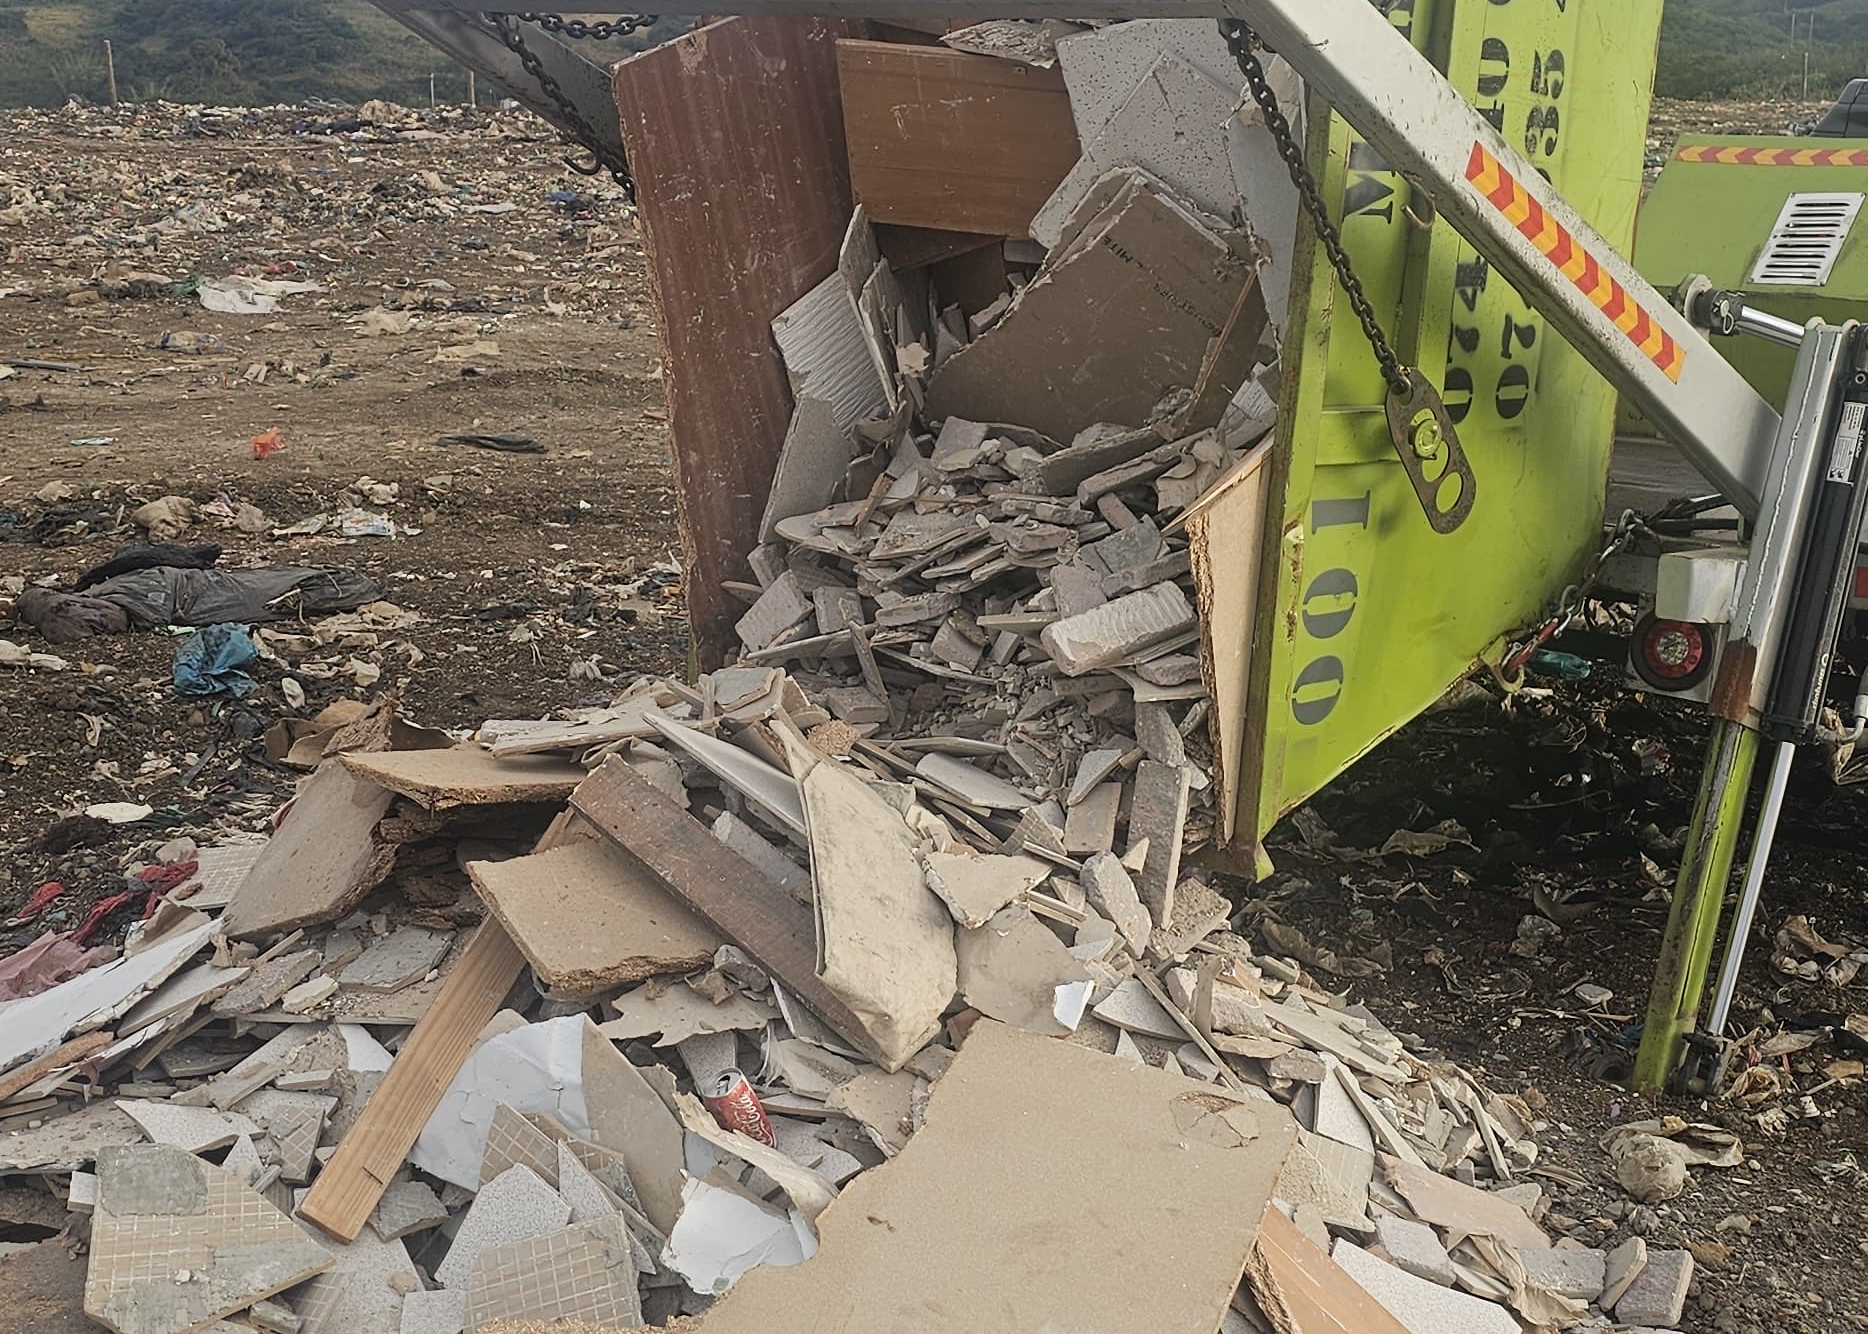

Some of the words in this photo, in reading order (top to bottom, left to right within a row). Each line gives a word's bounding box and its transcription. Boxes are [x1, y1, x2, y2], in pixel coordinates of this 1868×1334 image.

[1496, 293, 1536, 419] 07
[1525, 48, 1566, 184] 35
[1291, 488, 1371, 726] 001
